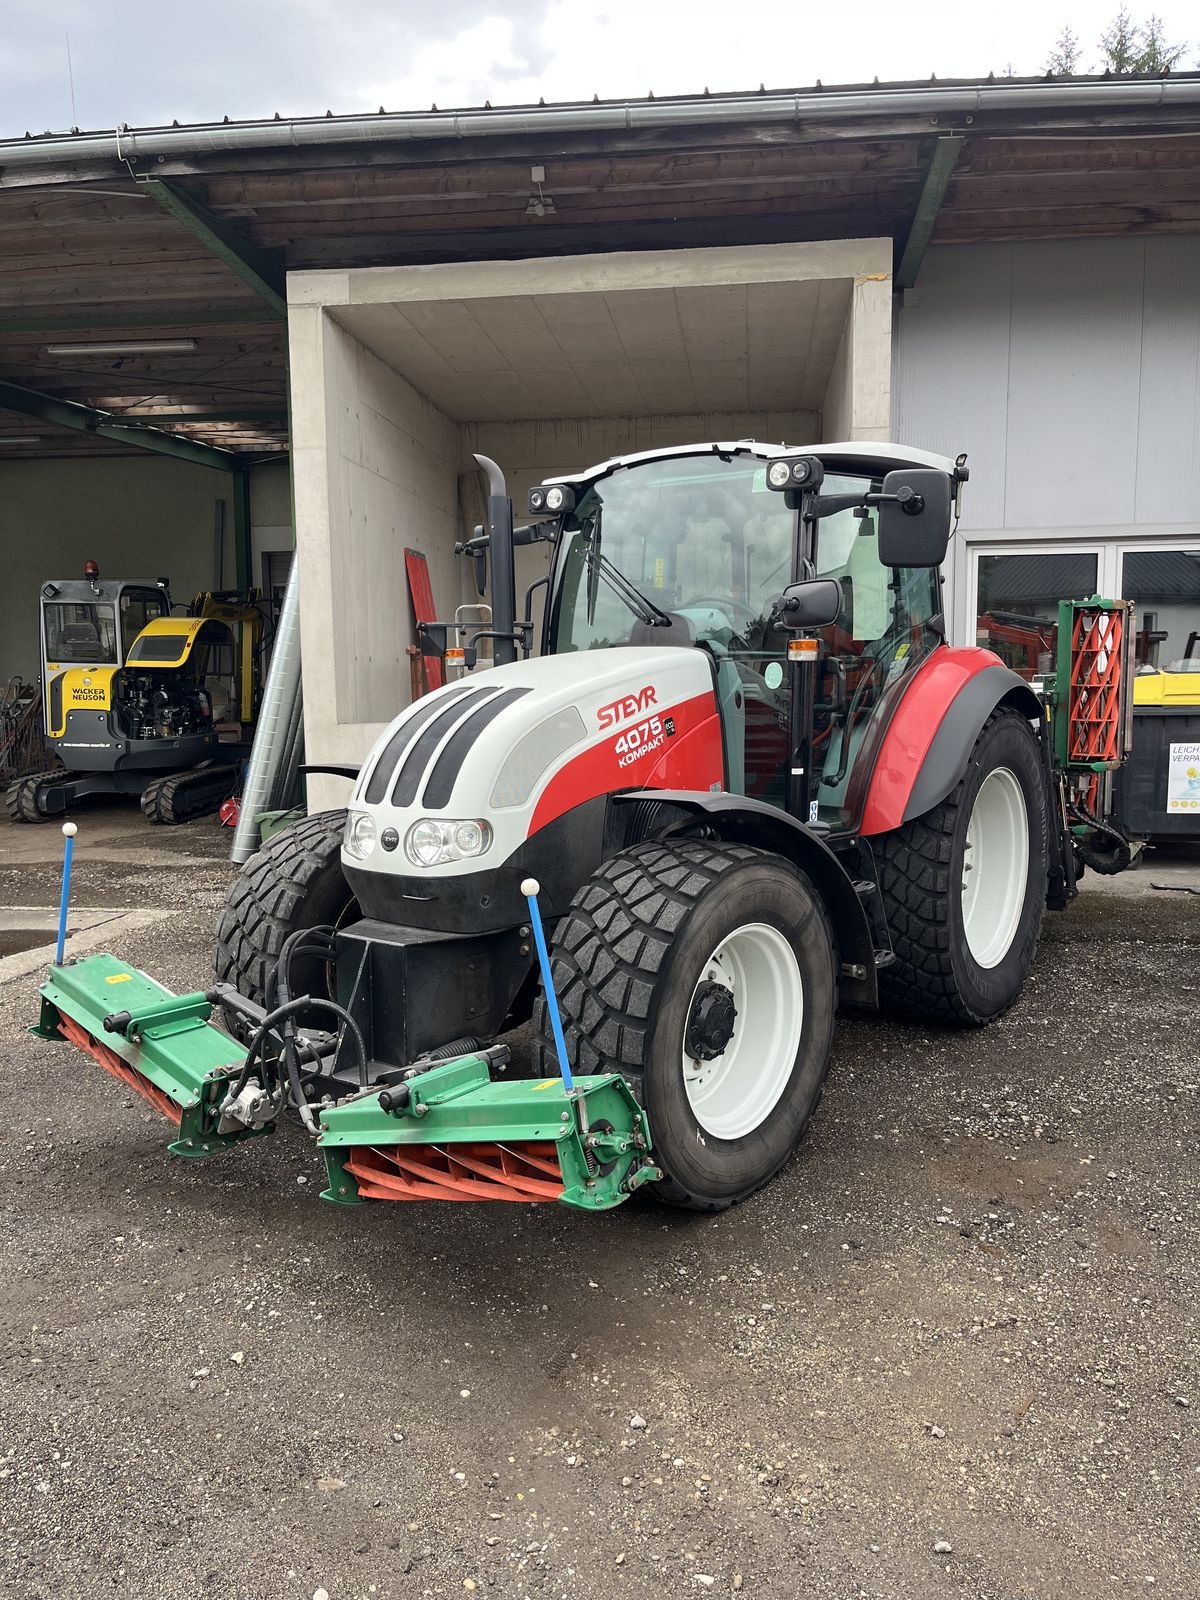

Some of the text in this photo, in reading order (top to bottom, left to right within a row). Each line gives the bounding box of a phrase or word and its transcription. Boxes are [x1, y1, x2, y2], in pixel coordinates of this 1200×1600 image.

[597, 685, 658, 731] STEYR
[615, 716, 662, 754] 4075
[618, 734, 665, 768] KOMPAKT
